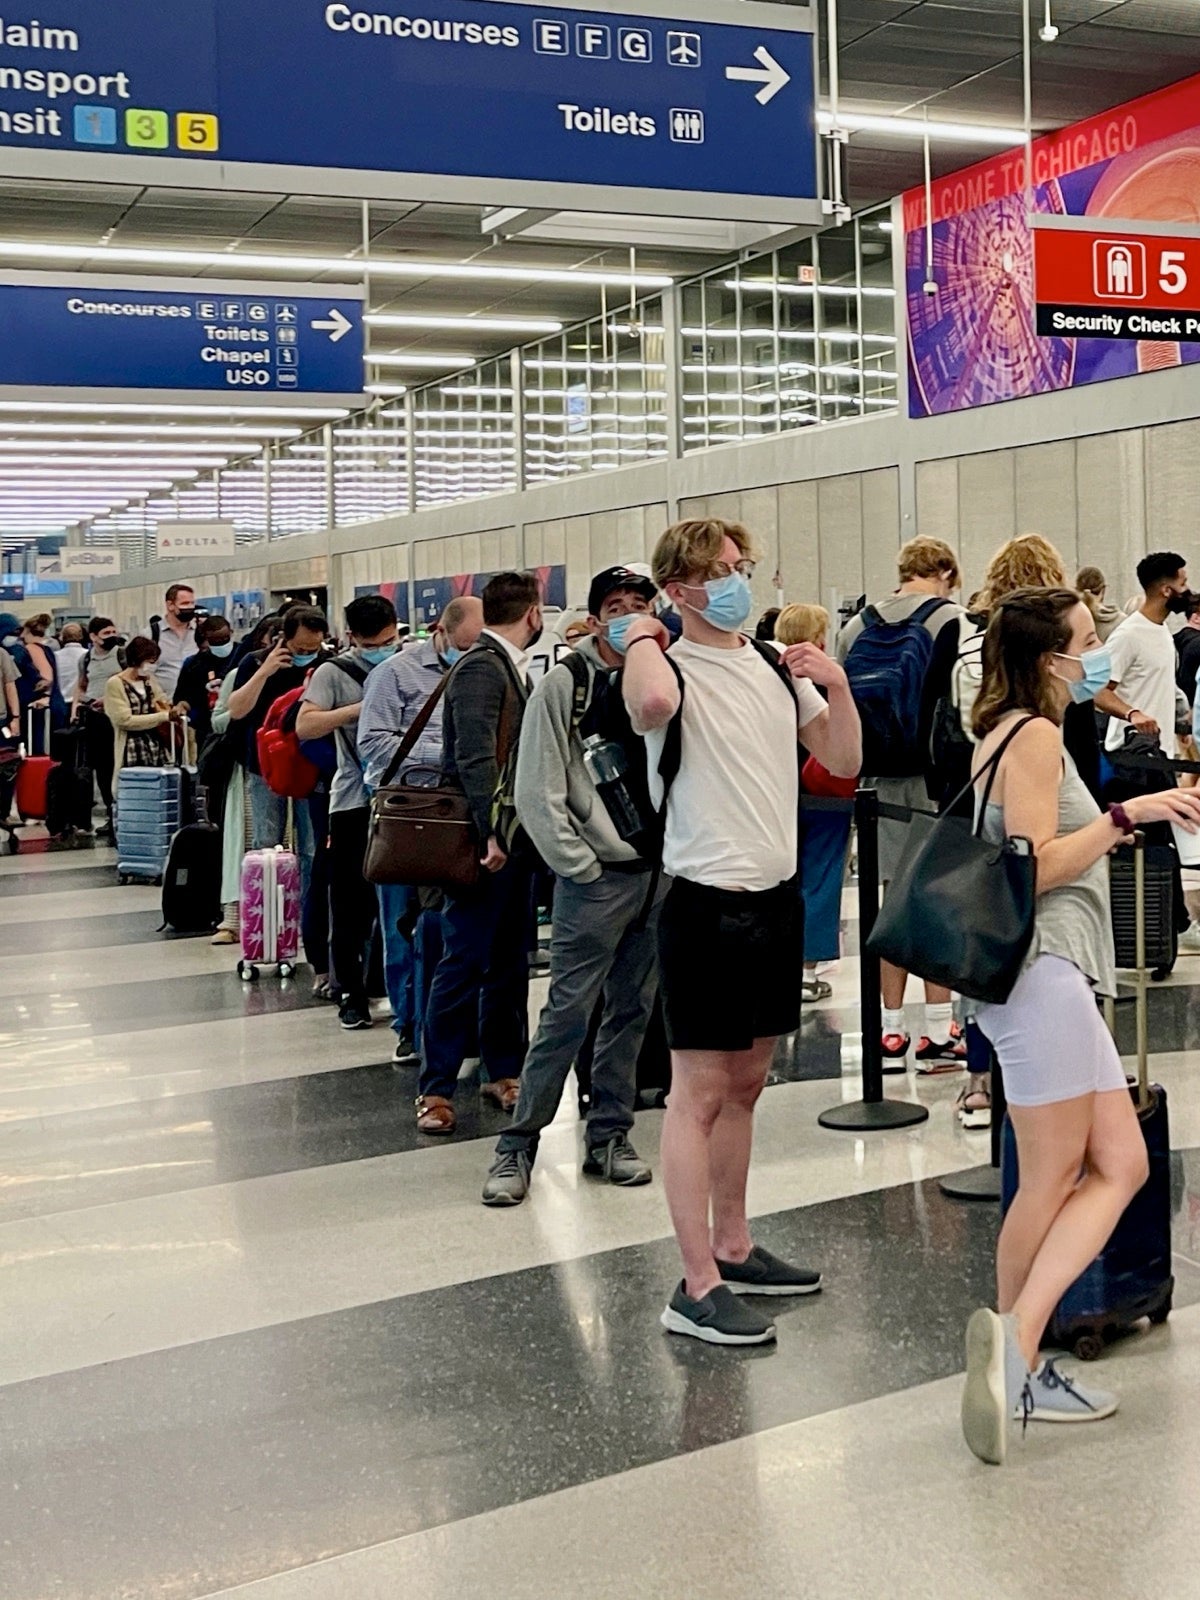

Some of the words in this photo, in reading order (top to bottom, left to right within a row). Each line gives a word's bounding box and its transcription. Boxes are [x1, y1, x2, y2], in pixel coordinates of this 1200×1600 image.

[325, 4, 519, 47] Concourses
[541, 25, 562, 50] E
[585, 29, 602, 53] F
[623, 33, 647, 58] G
[0, 66, 130, 98] nsport
[136, 115, 157, 140] 3
[188, 119, 207, 144] 5
[558, 104, 656, 136] Toilets
[1035, 115, 1137, 185] CHICAGO
[1159, 251, 1187, 294] 5
[67, 298, 191, 318] Concourses
[200, 303, 214, 318] E
[226, 305, 238, 319] F
[249, 305, 266, 320] G
[204, 325, 269, 341] Toilets
[1052, 312, 1123, 335] Security
[1128, 316, 1182, 334] Check
[201, 347, 270, 365] Chapel
[226, 369, 270, 385] USO
[174, 538, 217, 546] DELTA
